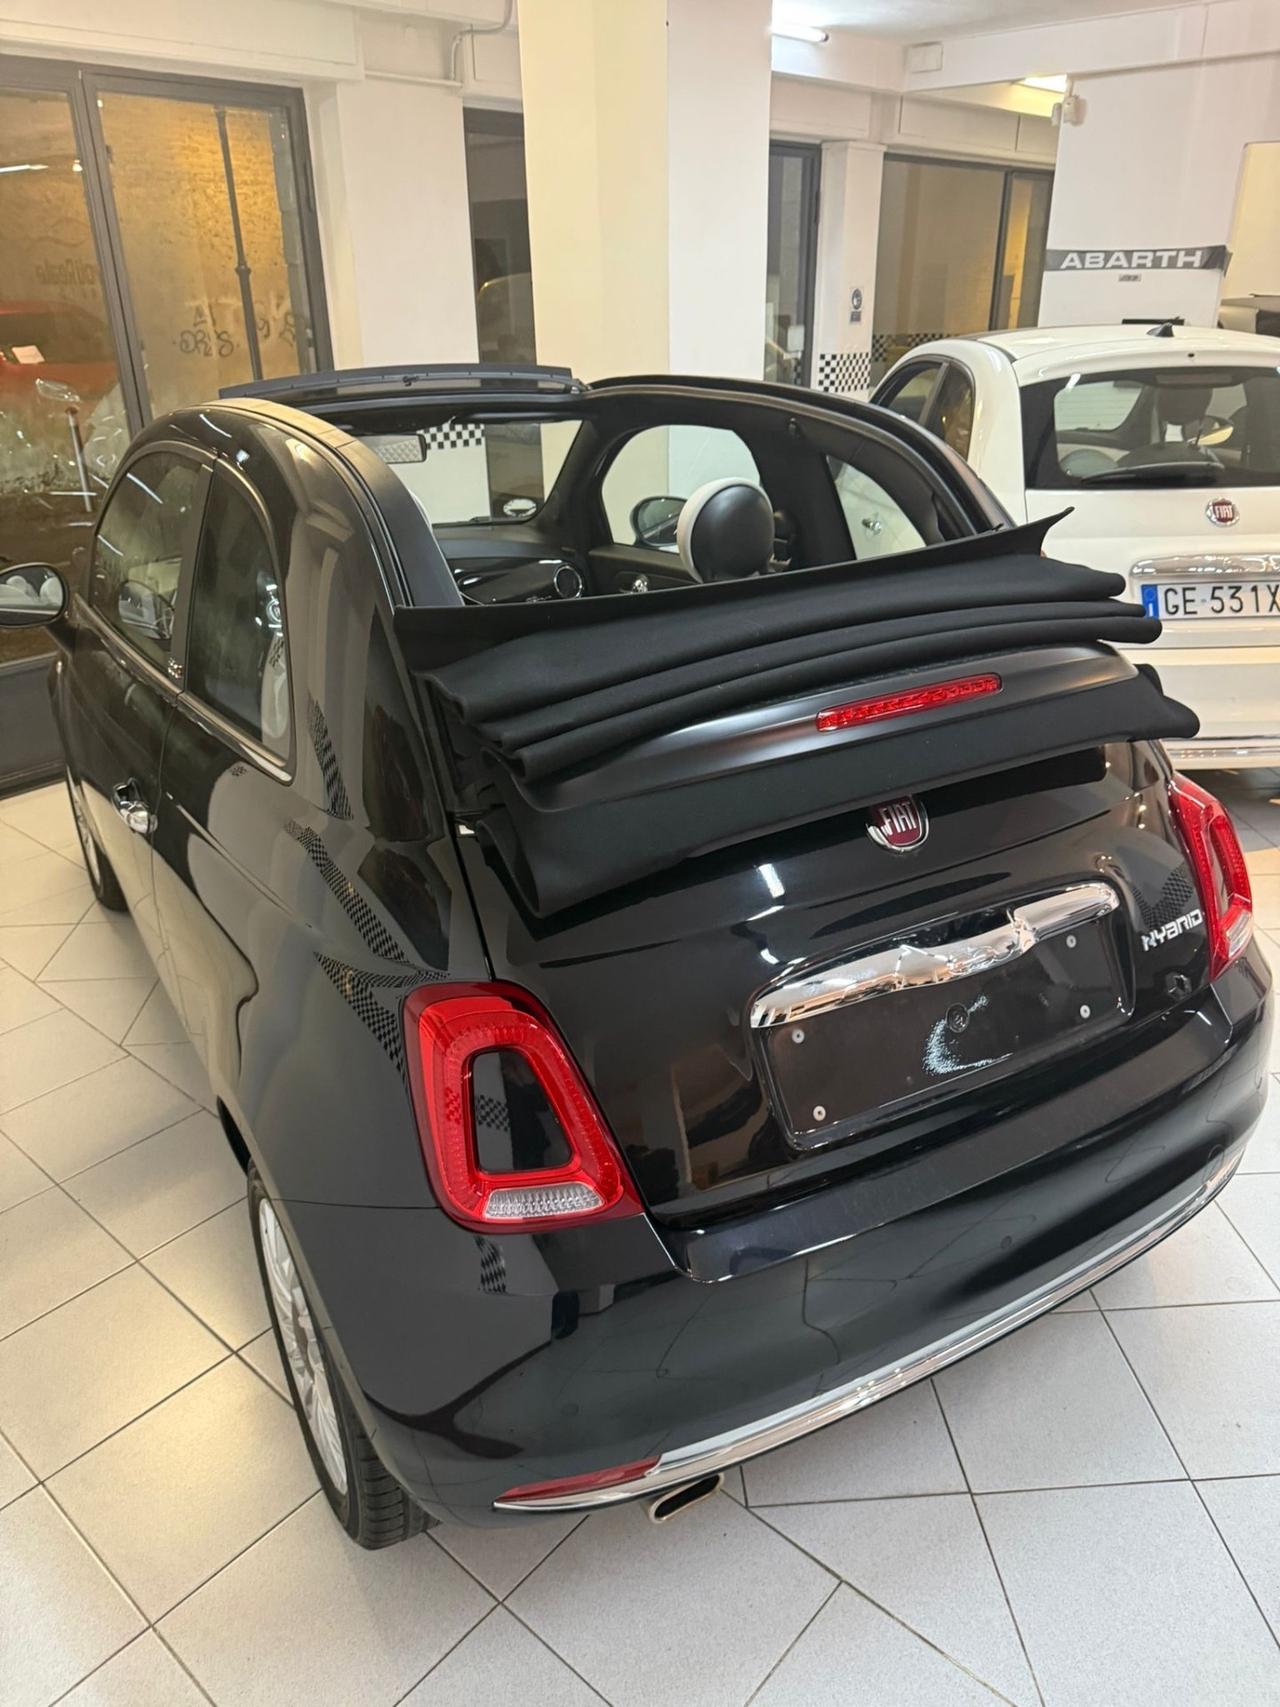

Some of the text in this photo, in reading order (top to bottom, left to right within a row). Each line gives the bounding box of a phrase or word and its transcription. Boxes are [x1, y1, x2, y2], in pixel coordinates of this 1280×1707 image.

[1060, 250, 1202, 269] ABARTH
[1214, 504, 1233, 518] FIAT
[1164, 587, 1198, 615] GE
[1210, 584, 1280, 613] 531X
[879, 801, 917, 836] FIAT
[1141, 909, 1203, 952] HYBRID
